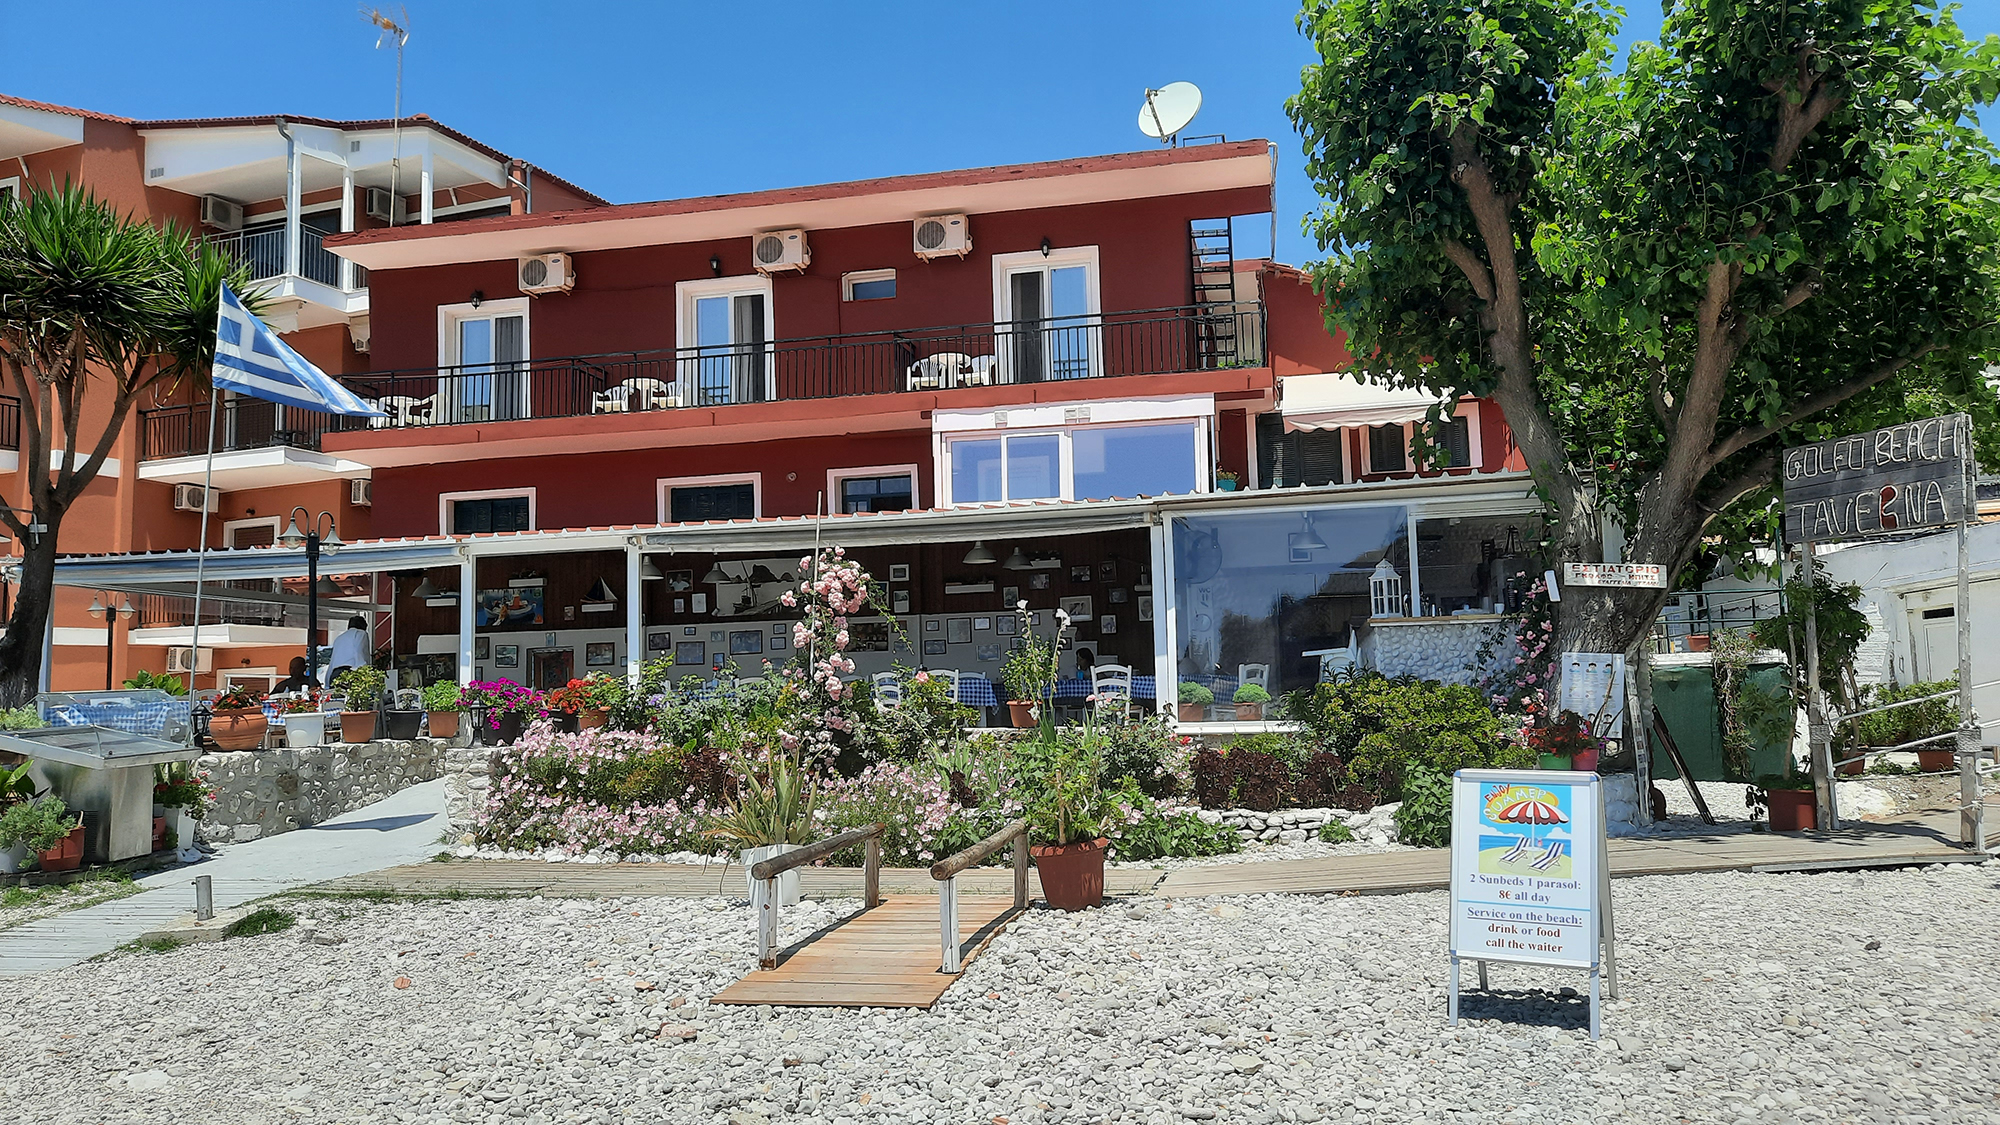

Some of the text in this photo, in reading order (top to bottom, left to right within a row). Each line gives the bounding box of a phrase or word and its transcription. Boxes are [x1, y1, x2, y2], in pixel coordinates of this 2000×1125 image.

[1786, 417, 1961, 481] GOLFO BEACH
[1792, 481, 1949, 537] TAVERNA
[1572, 564, 1660, 575] ΕΣΤΙΑΤΟΡΙΟ
[1484, 783, 1510, 802] ENJOY
[1483, 788, 1547, 820] SUMMER
[1470, 873, 1581, 890] 2 Sunbeds 1 parasol:
[1499, 890, 1551, 904] 8€ all day
[1467, 907, 1506, 918] Service
[1526, 912, 1543, 921] the
[1546, 913, 1582, 925] beach:
[1488, 923, 1518, 934] drink
[1537, 927, 1561, 938] food
[1485, 938, 1563, 952] call the waiter
